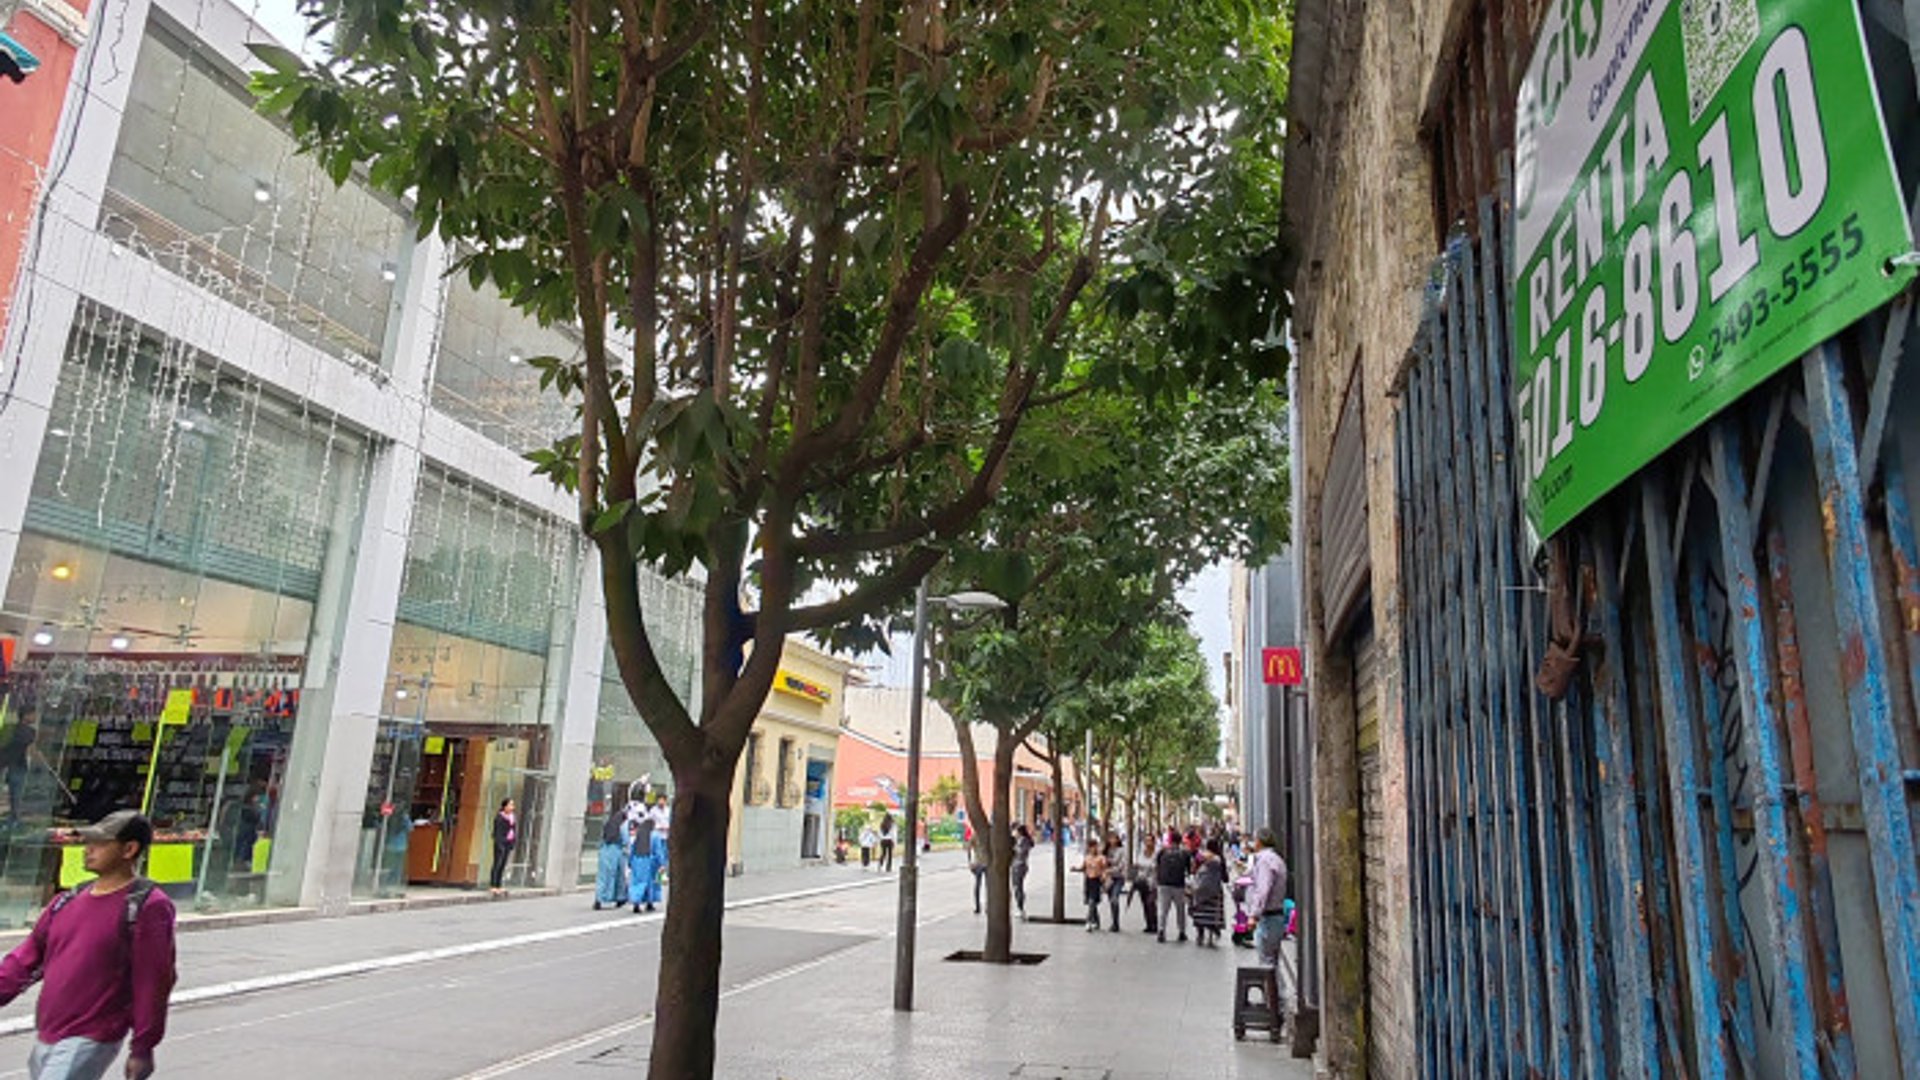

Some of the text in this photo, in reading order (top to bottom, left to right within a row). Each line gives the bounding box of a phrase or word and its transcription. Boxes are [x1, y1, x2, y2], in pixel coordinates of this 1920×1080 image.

[1519, 25, 1828, 498] 5016-8610
[1530, 70, 1669, 354] RENTA
[1709, 213, 1864, 364] 2493-5555
